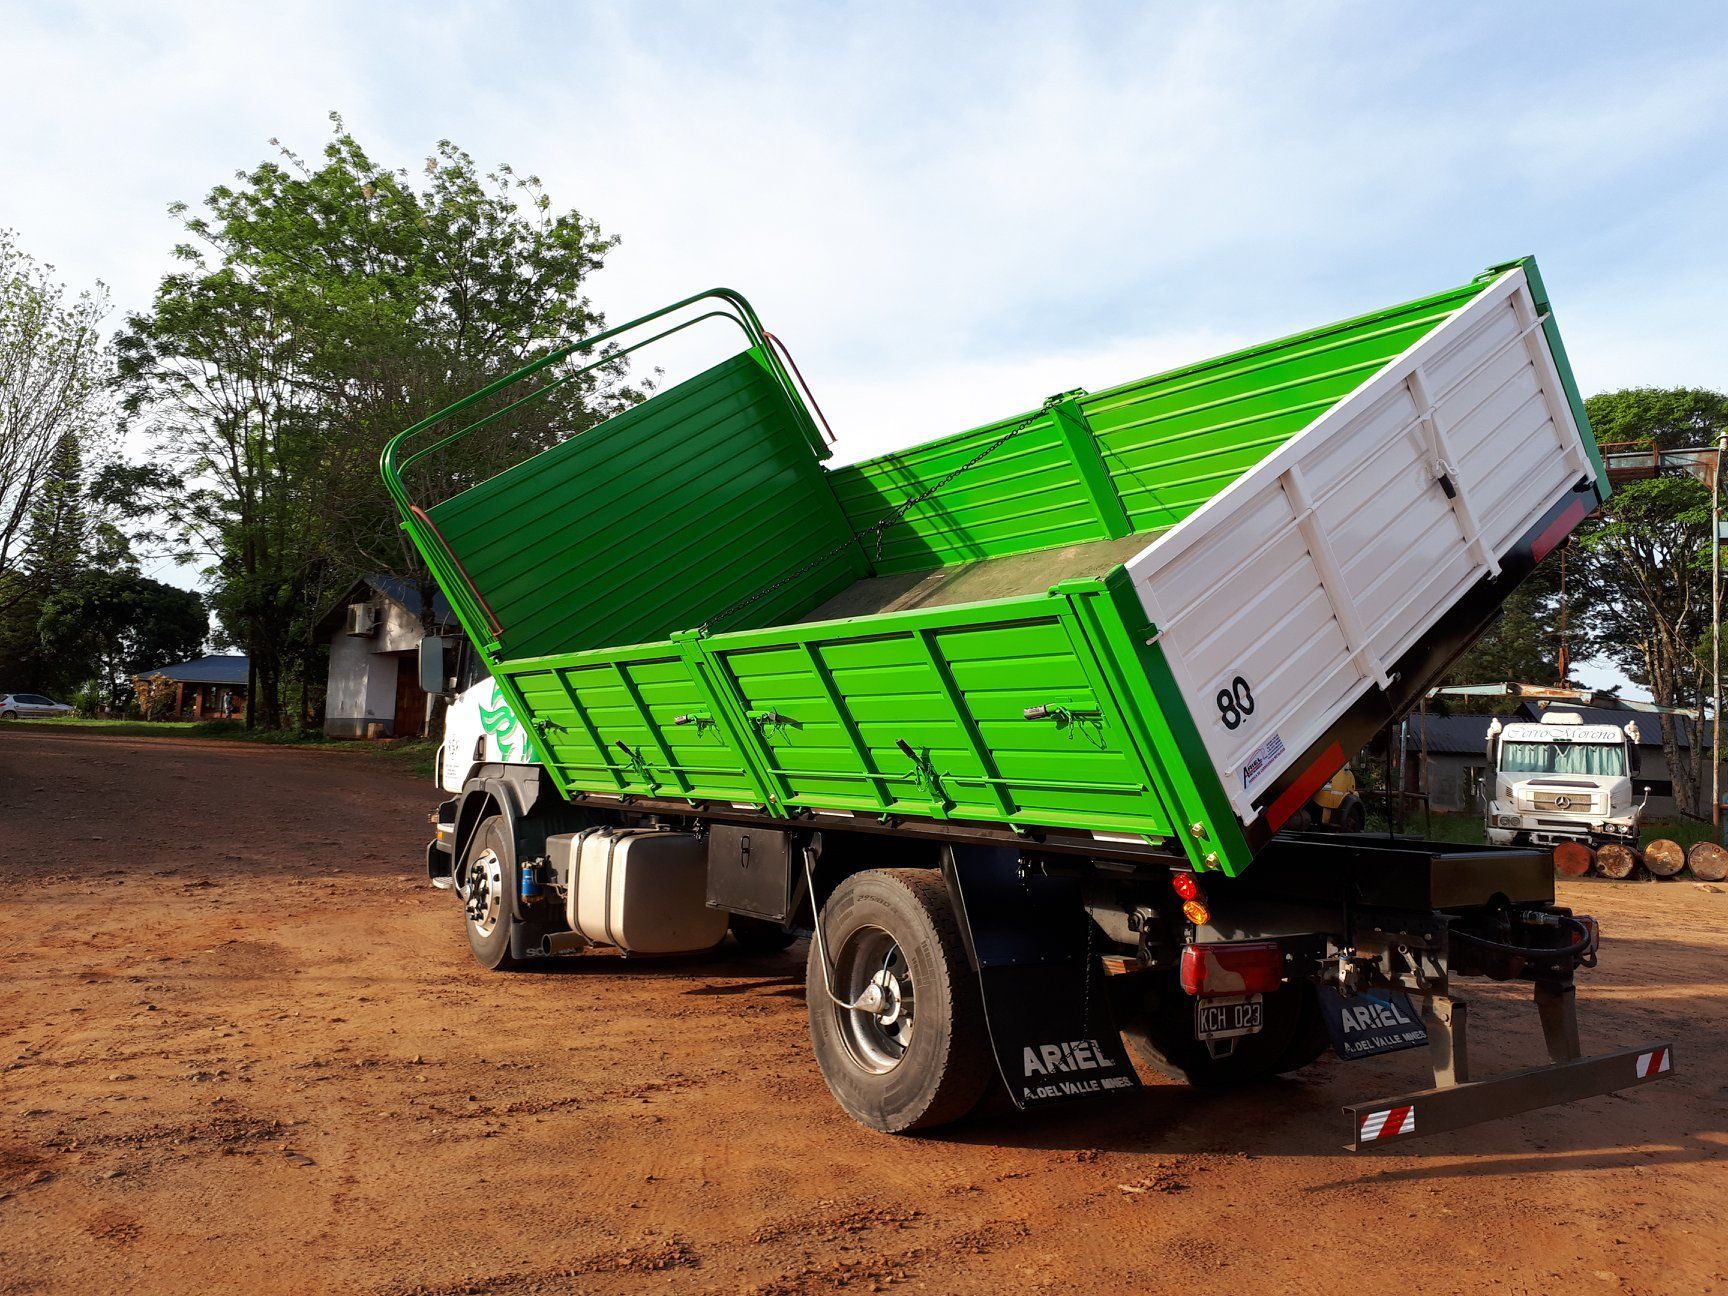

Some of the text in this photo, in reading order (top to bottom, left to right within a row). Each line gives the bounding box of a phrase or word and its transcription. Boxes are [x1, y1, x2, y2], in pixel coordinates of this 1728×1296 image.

[1216, 676, 1254, 730] 80
[1548, 727, 1616, 740] Moreno
[1200, 1004, 1260, 1032] KCH 023
[1342, 1003, 1411, 1033] ARIEL
[1354, 1039, 1375, 1052] DEL
[1372, 1034, 1402, 1048] VALLE
[1023, 1040, 1115, 1077] ARIEL
[1036, 1084, 1063, 1098] DEL
[1059, 1080, 1101, 1095] VALLE
